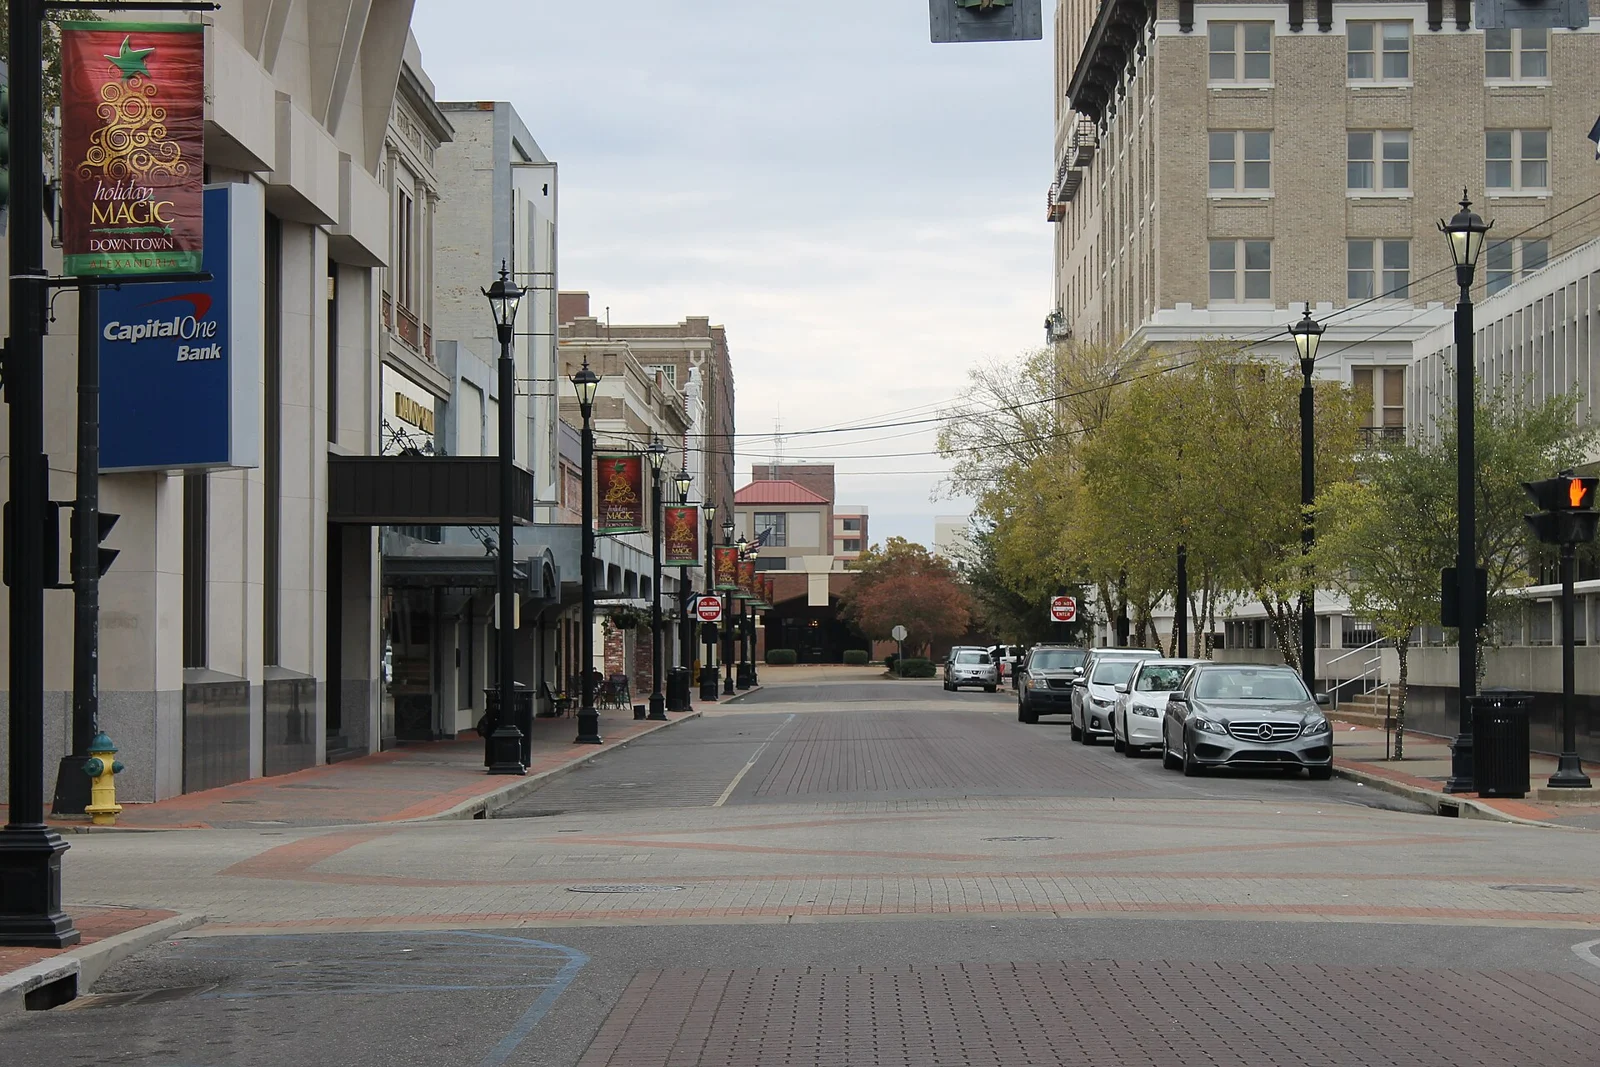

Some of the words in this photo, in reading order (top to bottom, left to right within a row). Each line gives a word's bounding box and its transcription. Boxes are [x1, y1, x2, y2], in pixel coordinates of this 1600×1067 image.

[93, 179, 154, 207] holiday
[90, 201, 175, 225] MAGIC
[90, 237, 174, 251] DOWNTOWN
[89, 258, 176, 269] ALEXANDRIA
[176, 343, 221, 361] Bank
[606, 511, 634, 520] MAGIC
